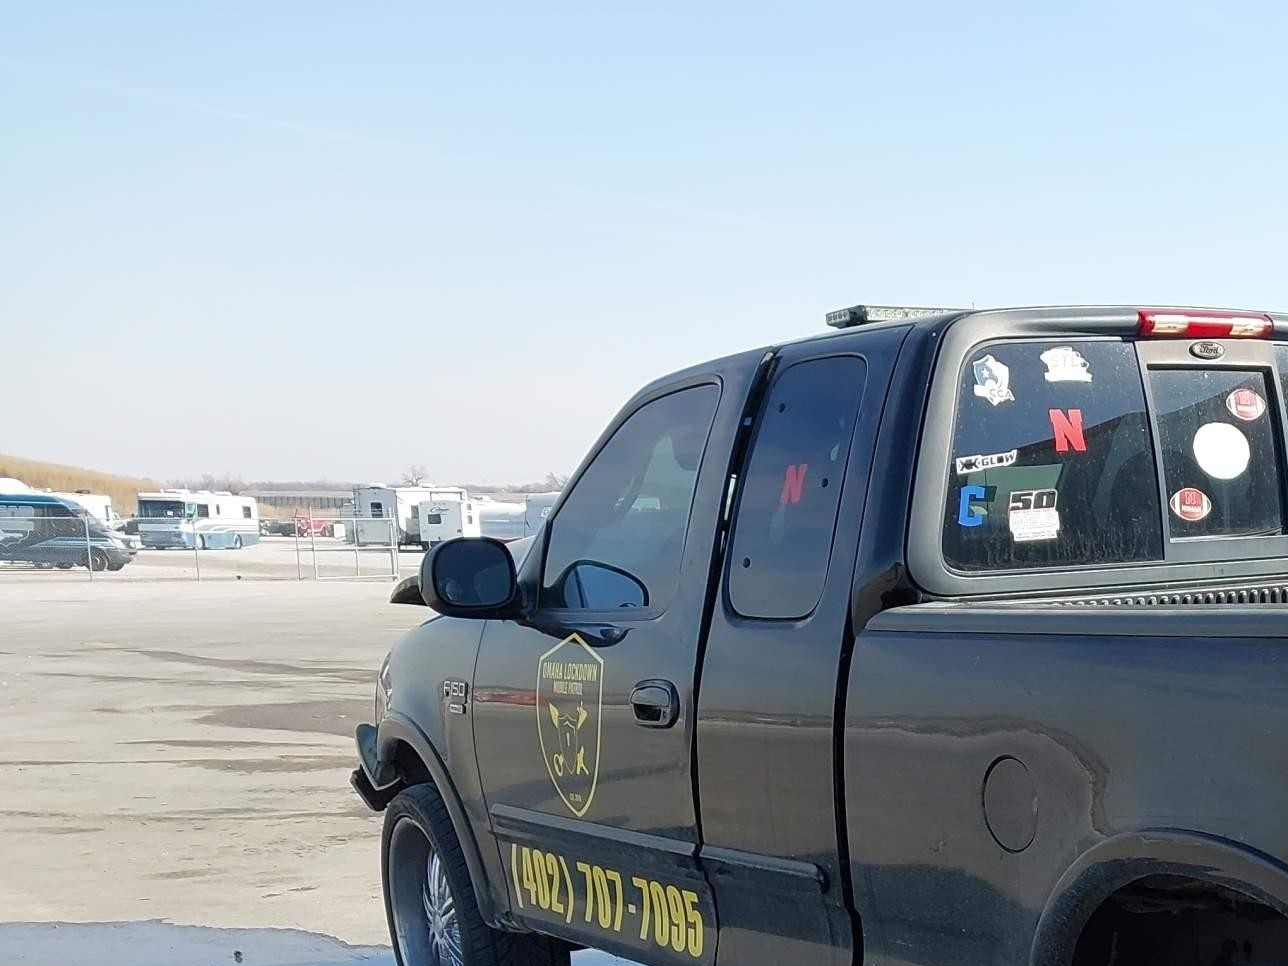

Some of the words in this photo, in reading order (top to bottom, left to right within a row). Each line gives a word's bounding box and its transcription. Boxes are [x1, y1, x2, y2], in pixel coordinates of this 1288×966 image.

[1049, 408, 1087, 451] N
[780, 463, 808, 504] N
[1010, 490, 1057, 511] 50
[542, 661, 563, 681] OMAHA
[564, 663, 598, 682] LOCKDOWN
[511, 843, 574, 924] (402)
[576, 861, 704, 958] 707-7095
